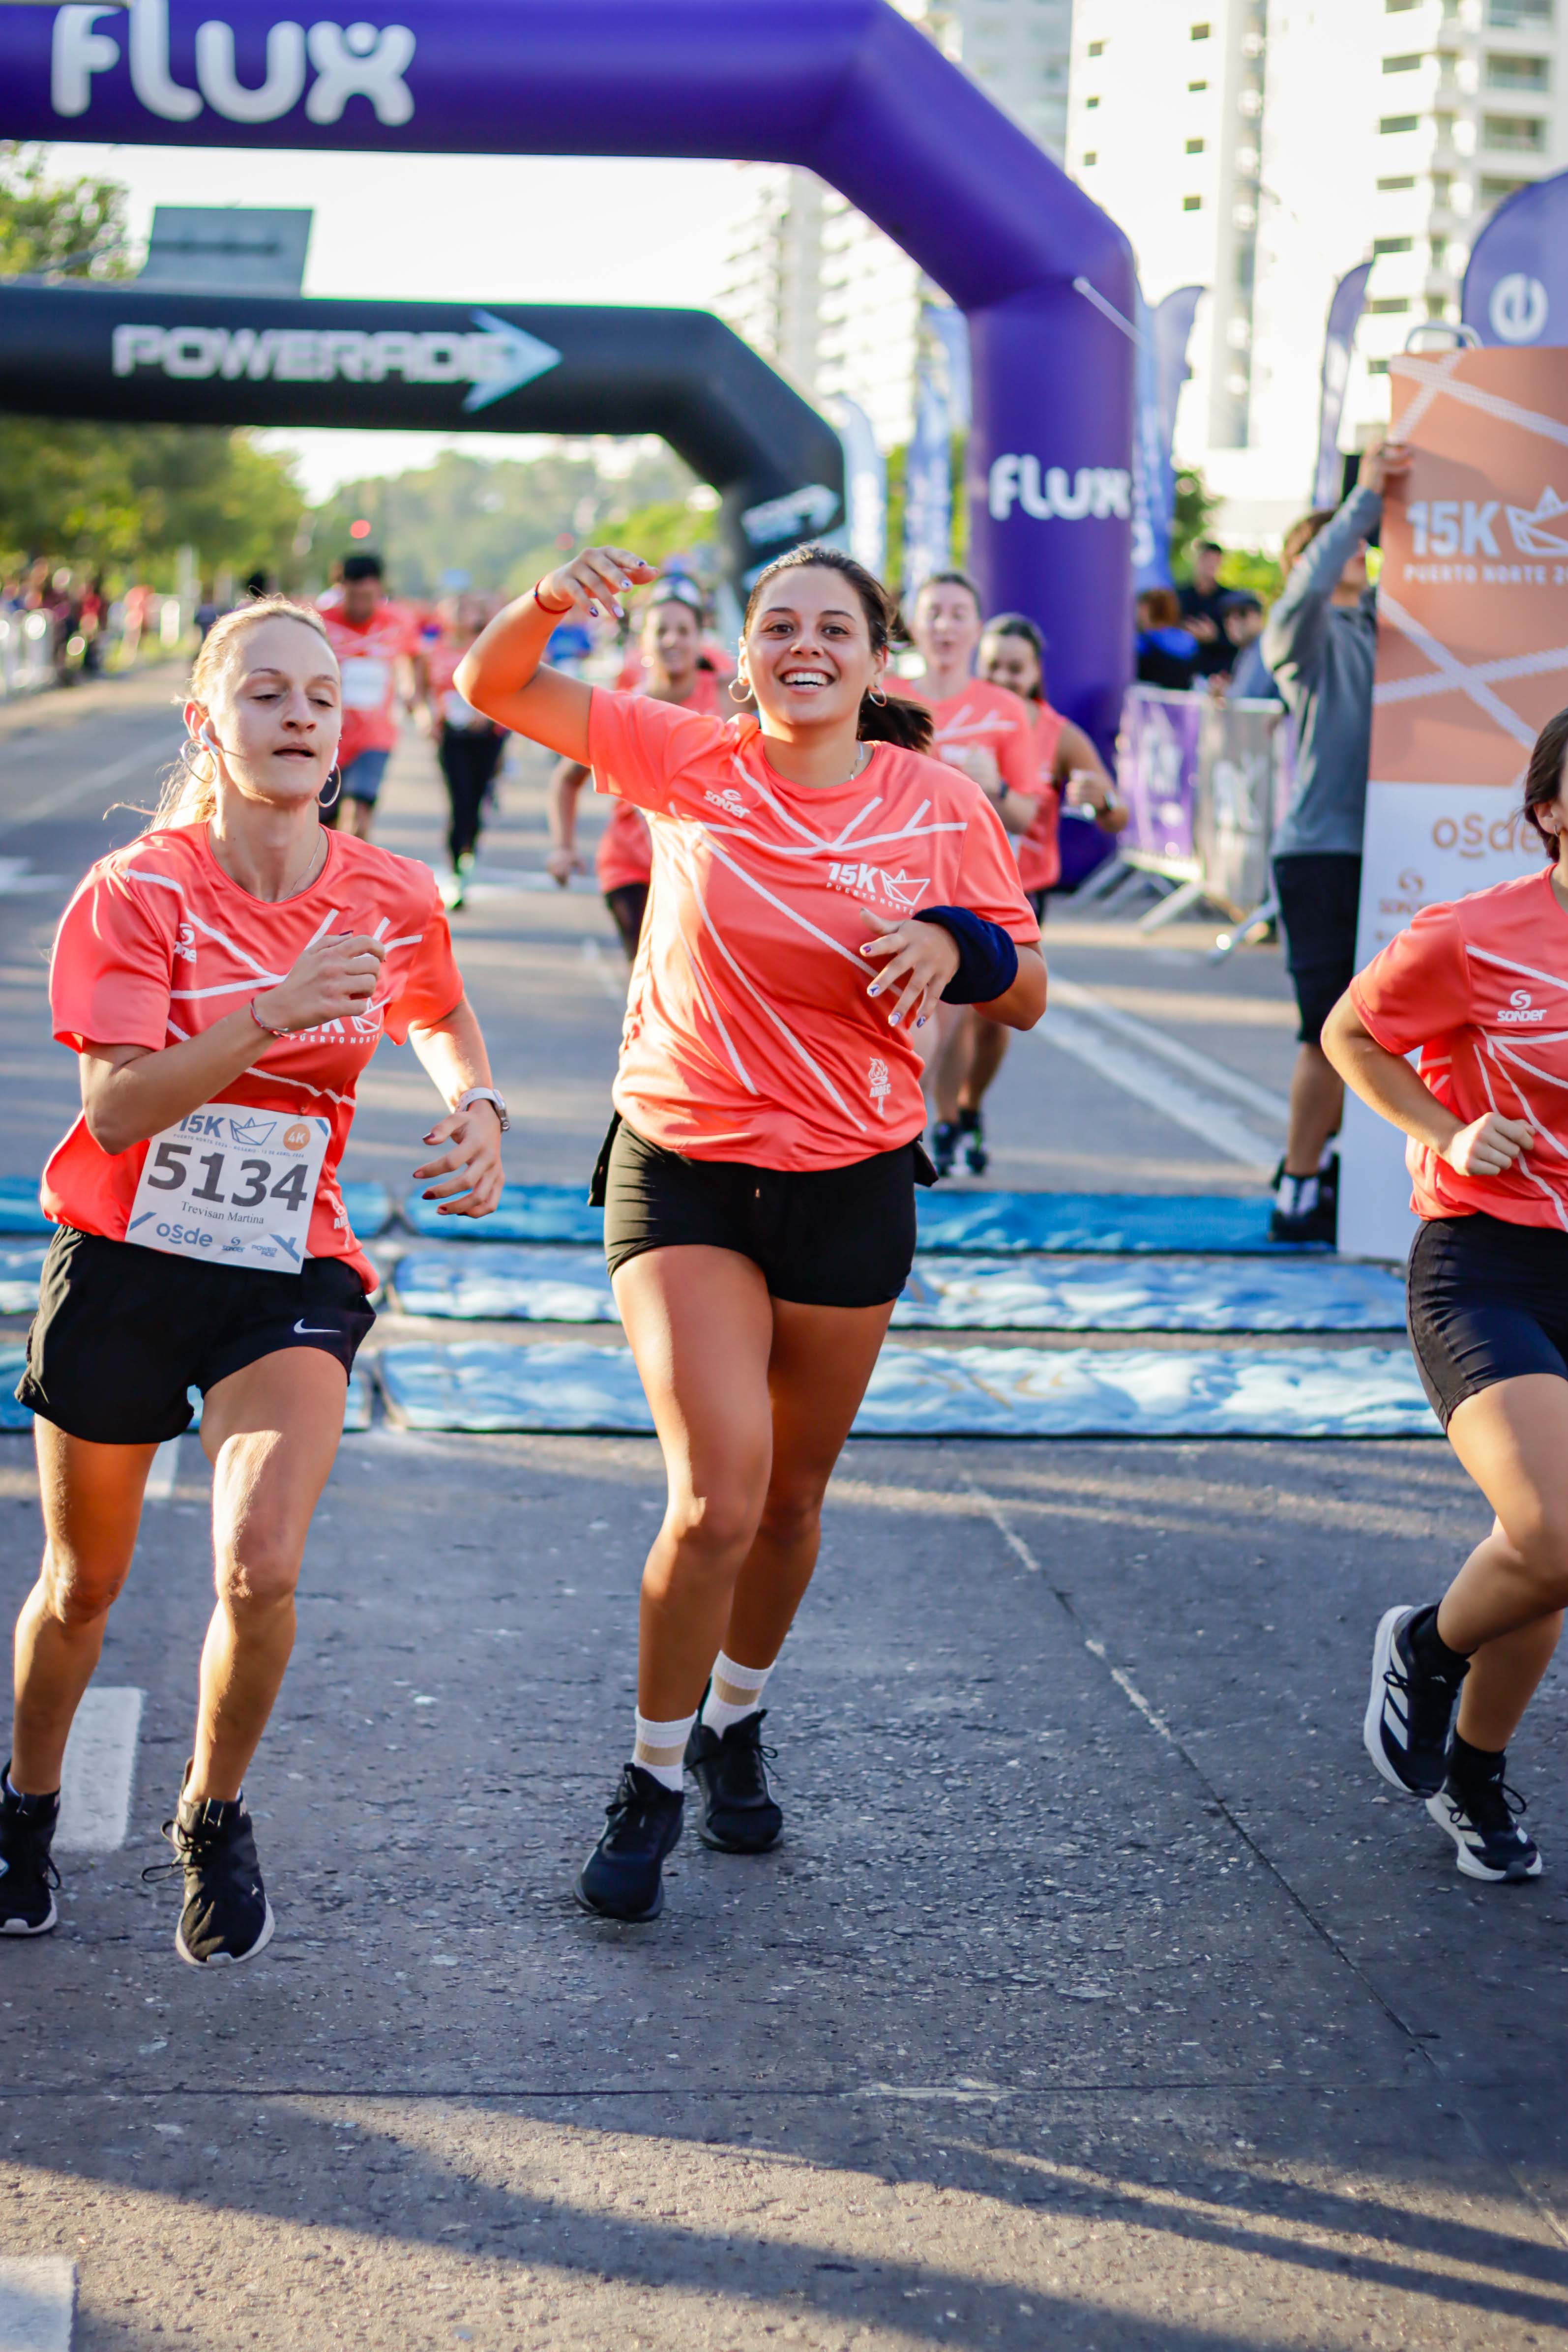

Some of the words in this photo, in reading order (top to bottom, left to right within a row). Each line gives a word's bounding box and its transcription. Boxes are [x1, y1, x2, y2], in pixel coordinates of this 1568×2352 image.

[112, 323, 514, 383] POWERADE
[1406, 500, 1501, 558] 15K
[1404, 563, 1477, 584] PUERTO
[1482, 564, 1546, 585] NORTE
[828, 862, 879, 893] 15K
[826, 882, 875, 901] PUERTO
[880, 897, 914, 915] NORTE
[290, 1033, 345, 1044] PUERTO
[288, 1131, 306, 1143] 4K
[148, 1142, 309, 1211] 5134
[181, 1201, 225, 1220] Trevisan
[227, 1211, 264, 1224] Martina
[156, 1222, 213, 1247] osde
[251, 1244, 278, 1252] POWER
